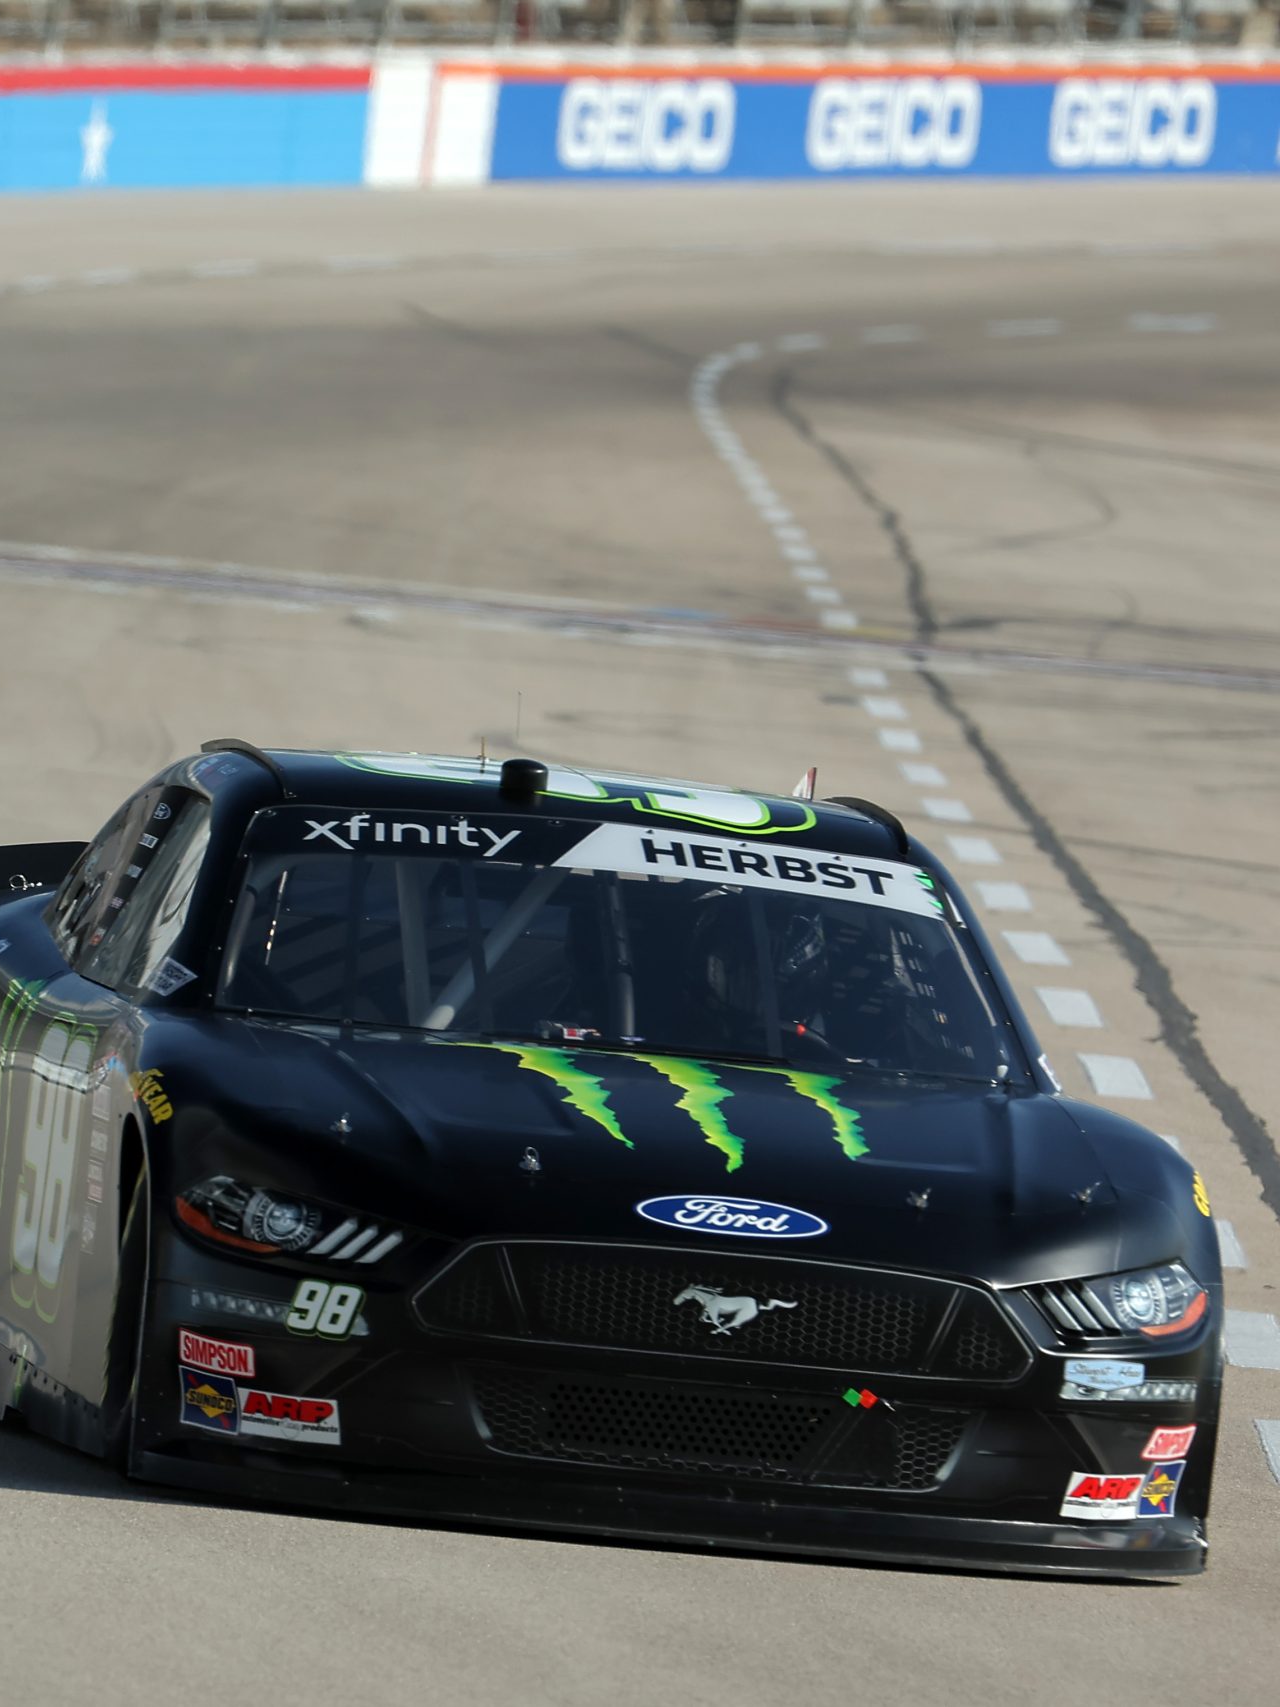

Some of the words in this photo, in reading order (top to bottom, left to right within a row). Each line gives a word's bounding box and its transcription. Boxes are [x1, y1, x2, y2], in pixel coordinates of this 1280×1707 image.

[558, 76, 736, 172] GEICO
[806, 76, 984, 168] GEICO
[1049, 76, 1219, 168] GEICO
[303, 814, 522, 858] xfinity
[642, 838, 894, 898] HERBST
[11, 1018, 94, 1289] 98
[674, 1199, 791, 1232] Ford
[286, 1279, 365, 1340] 98
[183, 1334, 250, 1374] SIMPSON
[187, 1390, 236, 1411] SUNOCO
[242, 1391, 334, 1424] ARP
[1070, 1476, 1142, 1500] ARP
